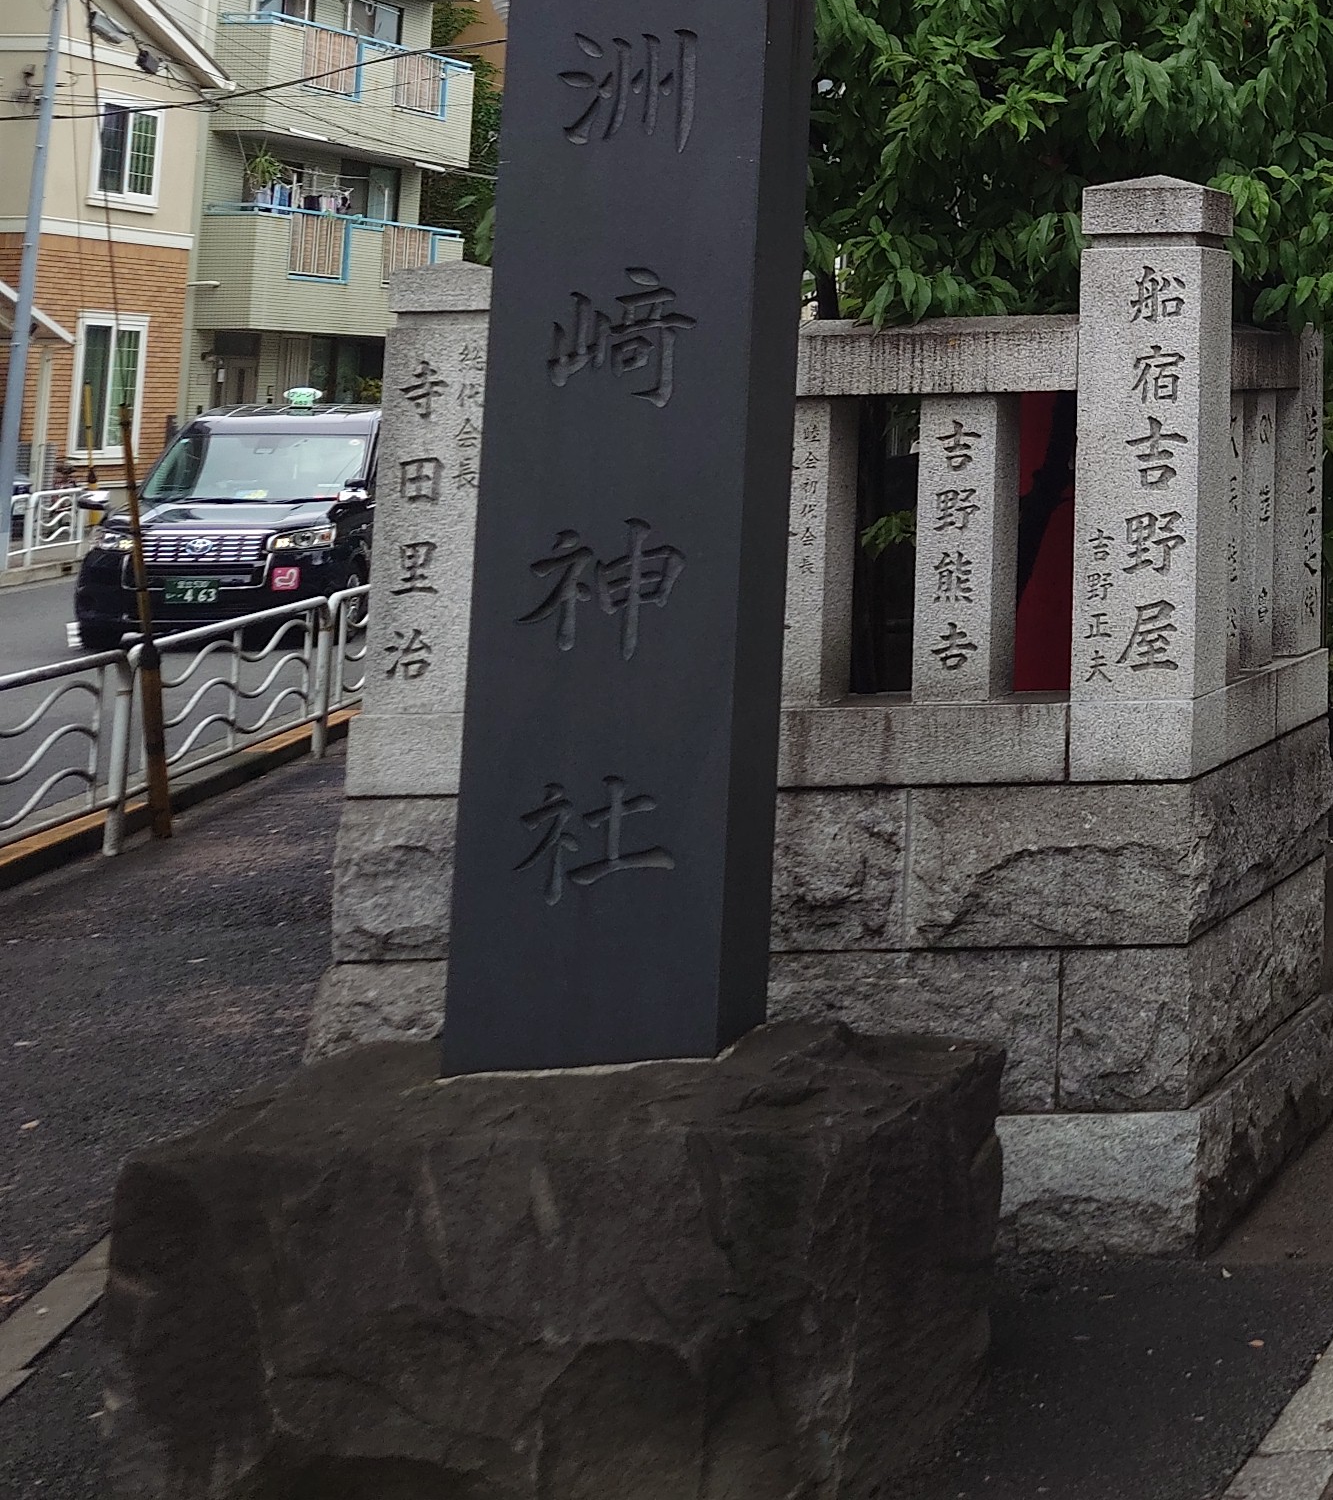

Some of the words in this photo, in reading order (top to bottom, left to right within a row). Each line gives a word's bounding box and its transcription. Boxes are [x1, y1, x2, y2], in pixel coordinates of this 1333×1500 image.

[383, 360, 449, 681] 寺田里治
[1083, 528, 1115, 684] 吉野正夫
[1116, 266, 1190, 672] 船宿吉野屋
